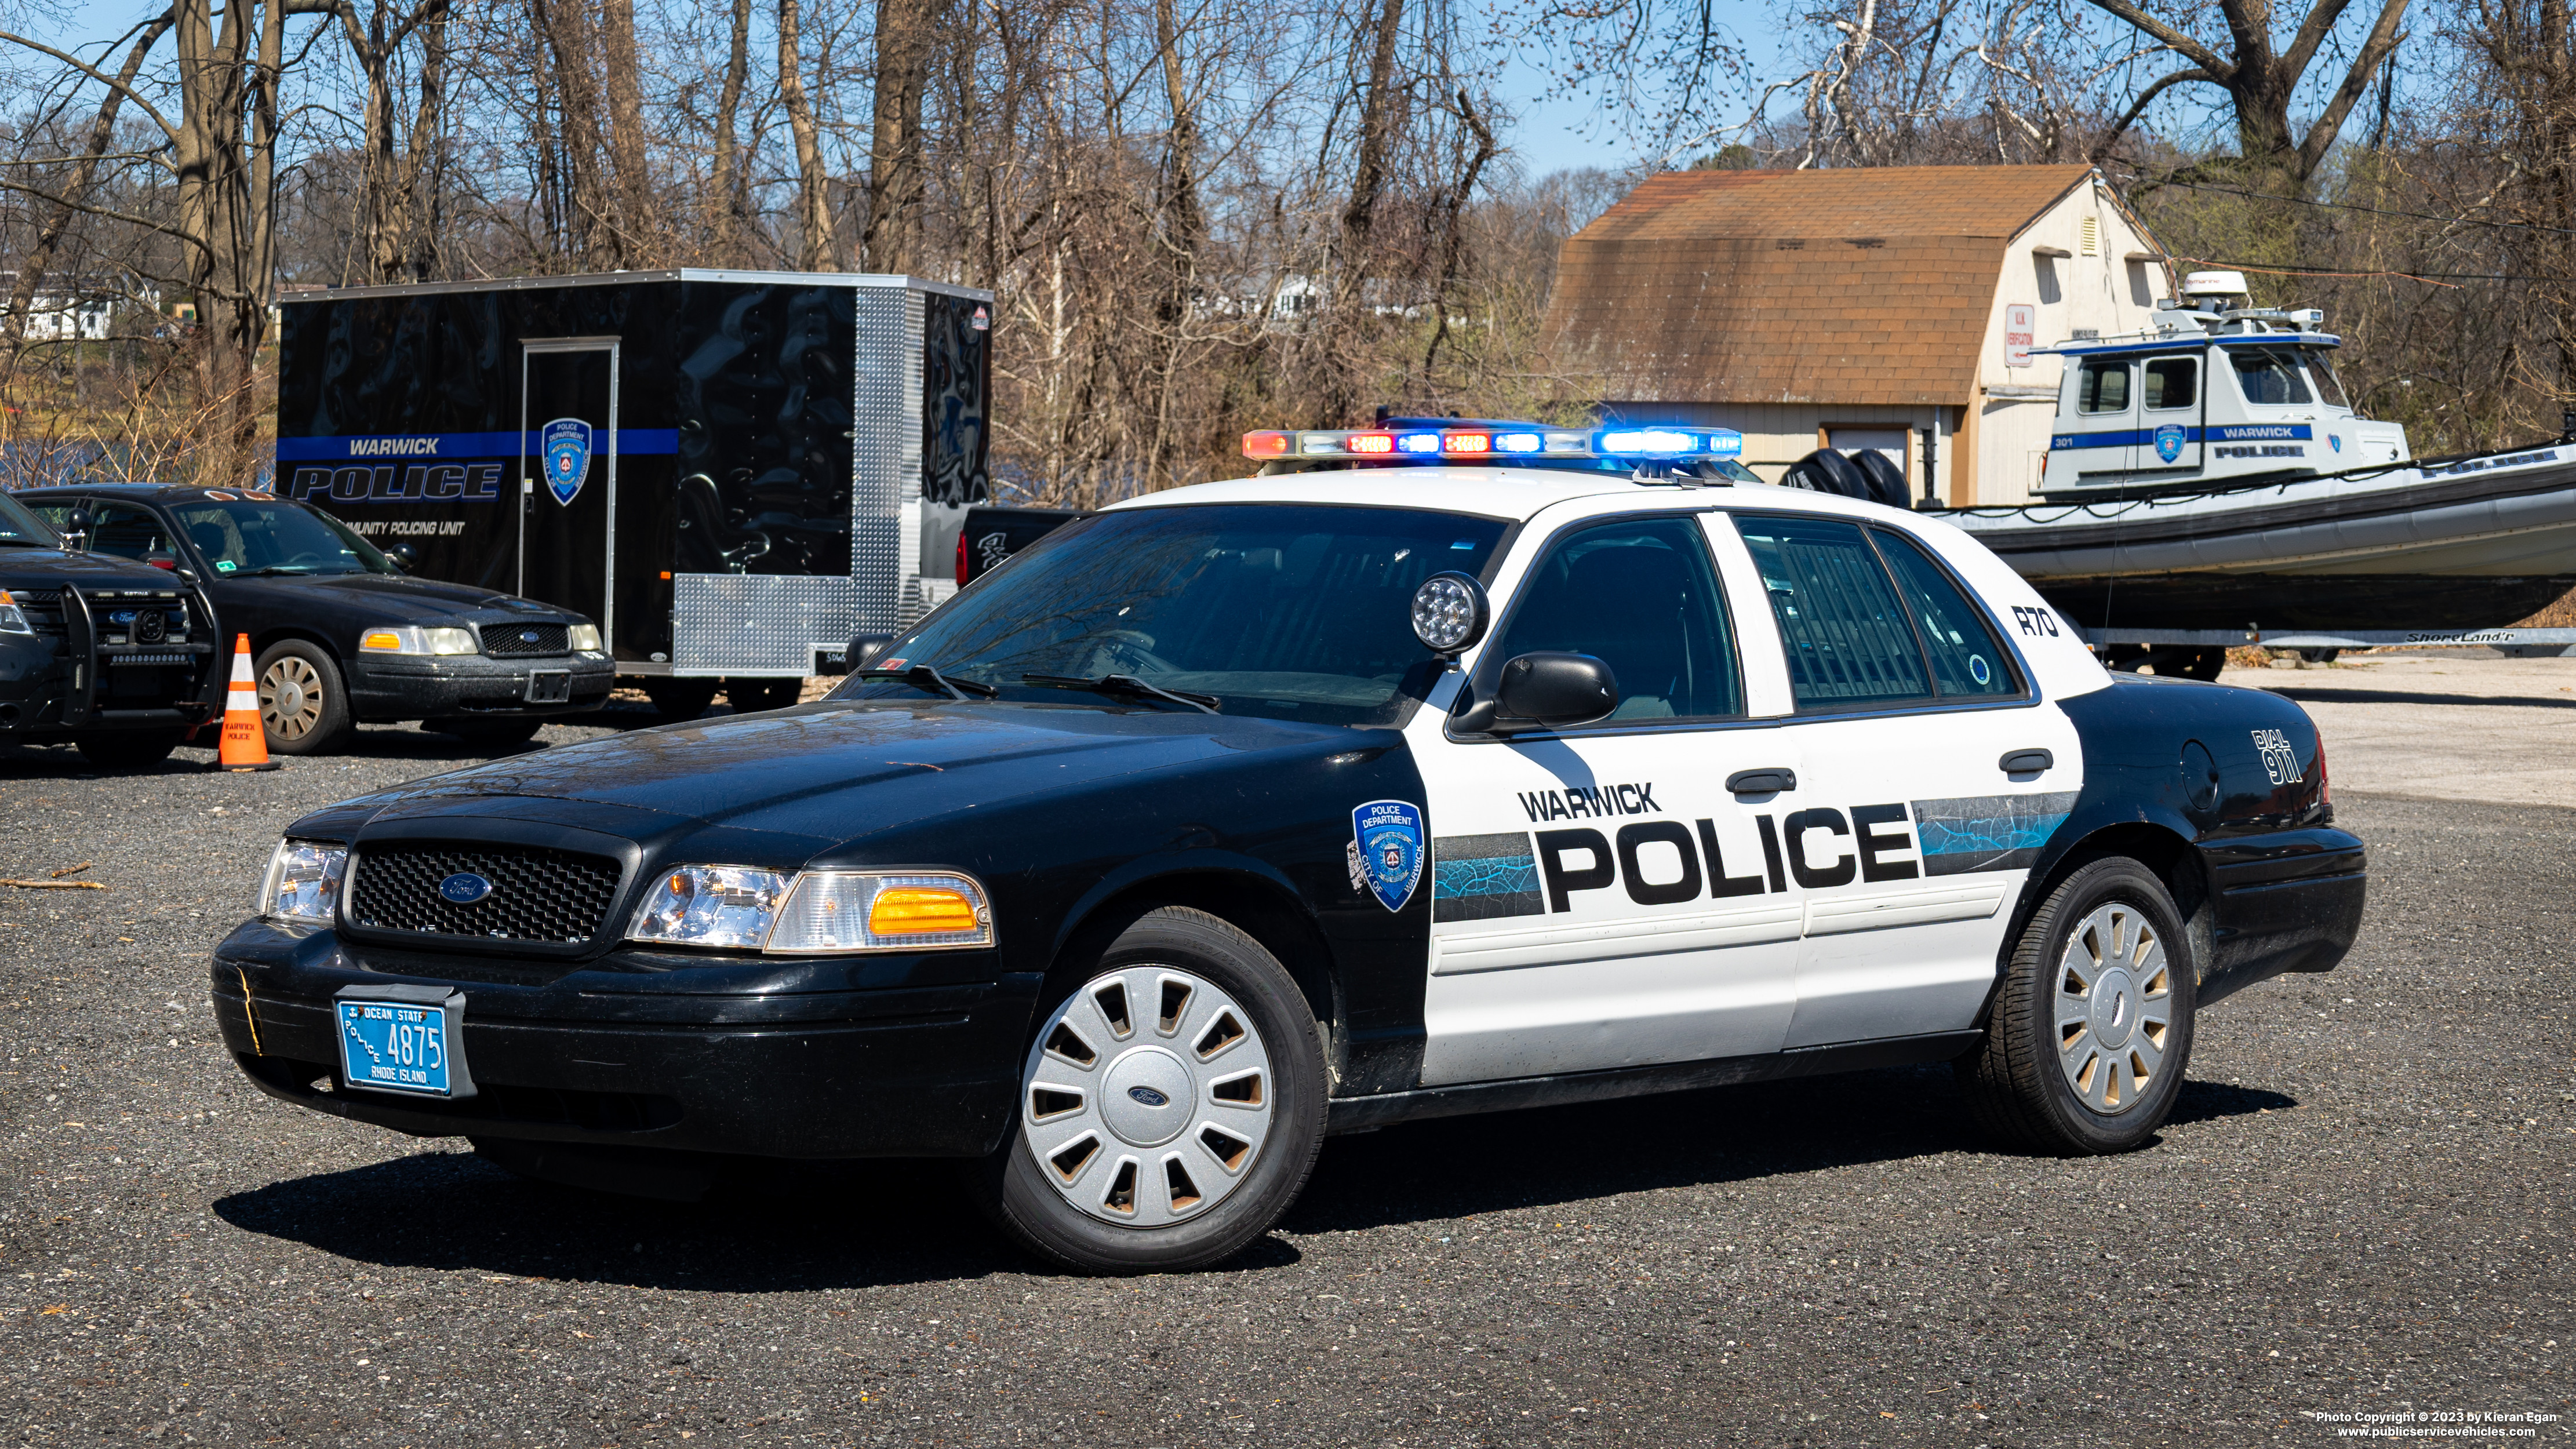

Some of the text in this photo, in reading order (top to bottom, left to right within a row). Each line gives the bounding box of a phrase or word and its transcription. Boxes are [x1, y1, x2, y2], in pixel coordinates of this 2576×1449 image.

[549, 431, 584, 442] DEPARTMENT
[2224, 427, 2294, 438] WARWICK
[350, 438, 439, 456] WARWICK
[2055, 438, 2072, 447] 301
[2214, 445, 2305, 458] POLICE
[574, 449, 590, 488] WARWICK
[291, 463, 503, 503] POLICE
[390, 522, 436, 536] POLICING
[439, 522, 465, 536] UNIT
[2010, 606, 2059, 637] R70
[2406, 632, 2515, 643] ShoreLand'r
[2251, 729, 2290, 749] DIAL
[2262, 748, 2303, 785] 911
[1371, 806, 1400, 816] POLICE
[1517, 782, 1662, 822] WARWICK
[1362, 815, 1412, 828] DEPARTMENT
[1534, 802, 1919, 914] POLICE
[1362, 855, 1384, 893] CITY OF
[1404, 844, 1422, 893] WARWICK
[450, 879, 478, 895] Ford
[365, 1008, 392, 1021] OCEAN
[345, 1020, 380, 1064] POLICE
[387, 1024, 441, 1069] 4875
[371, 1066, 427, 1084] RHODE ISLAND
[1137, 1091, 1159, 1103] Ford
